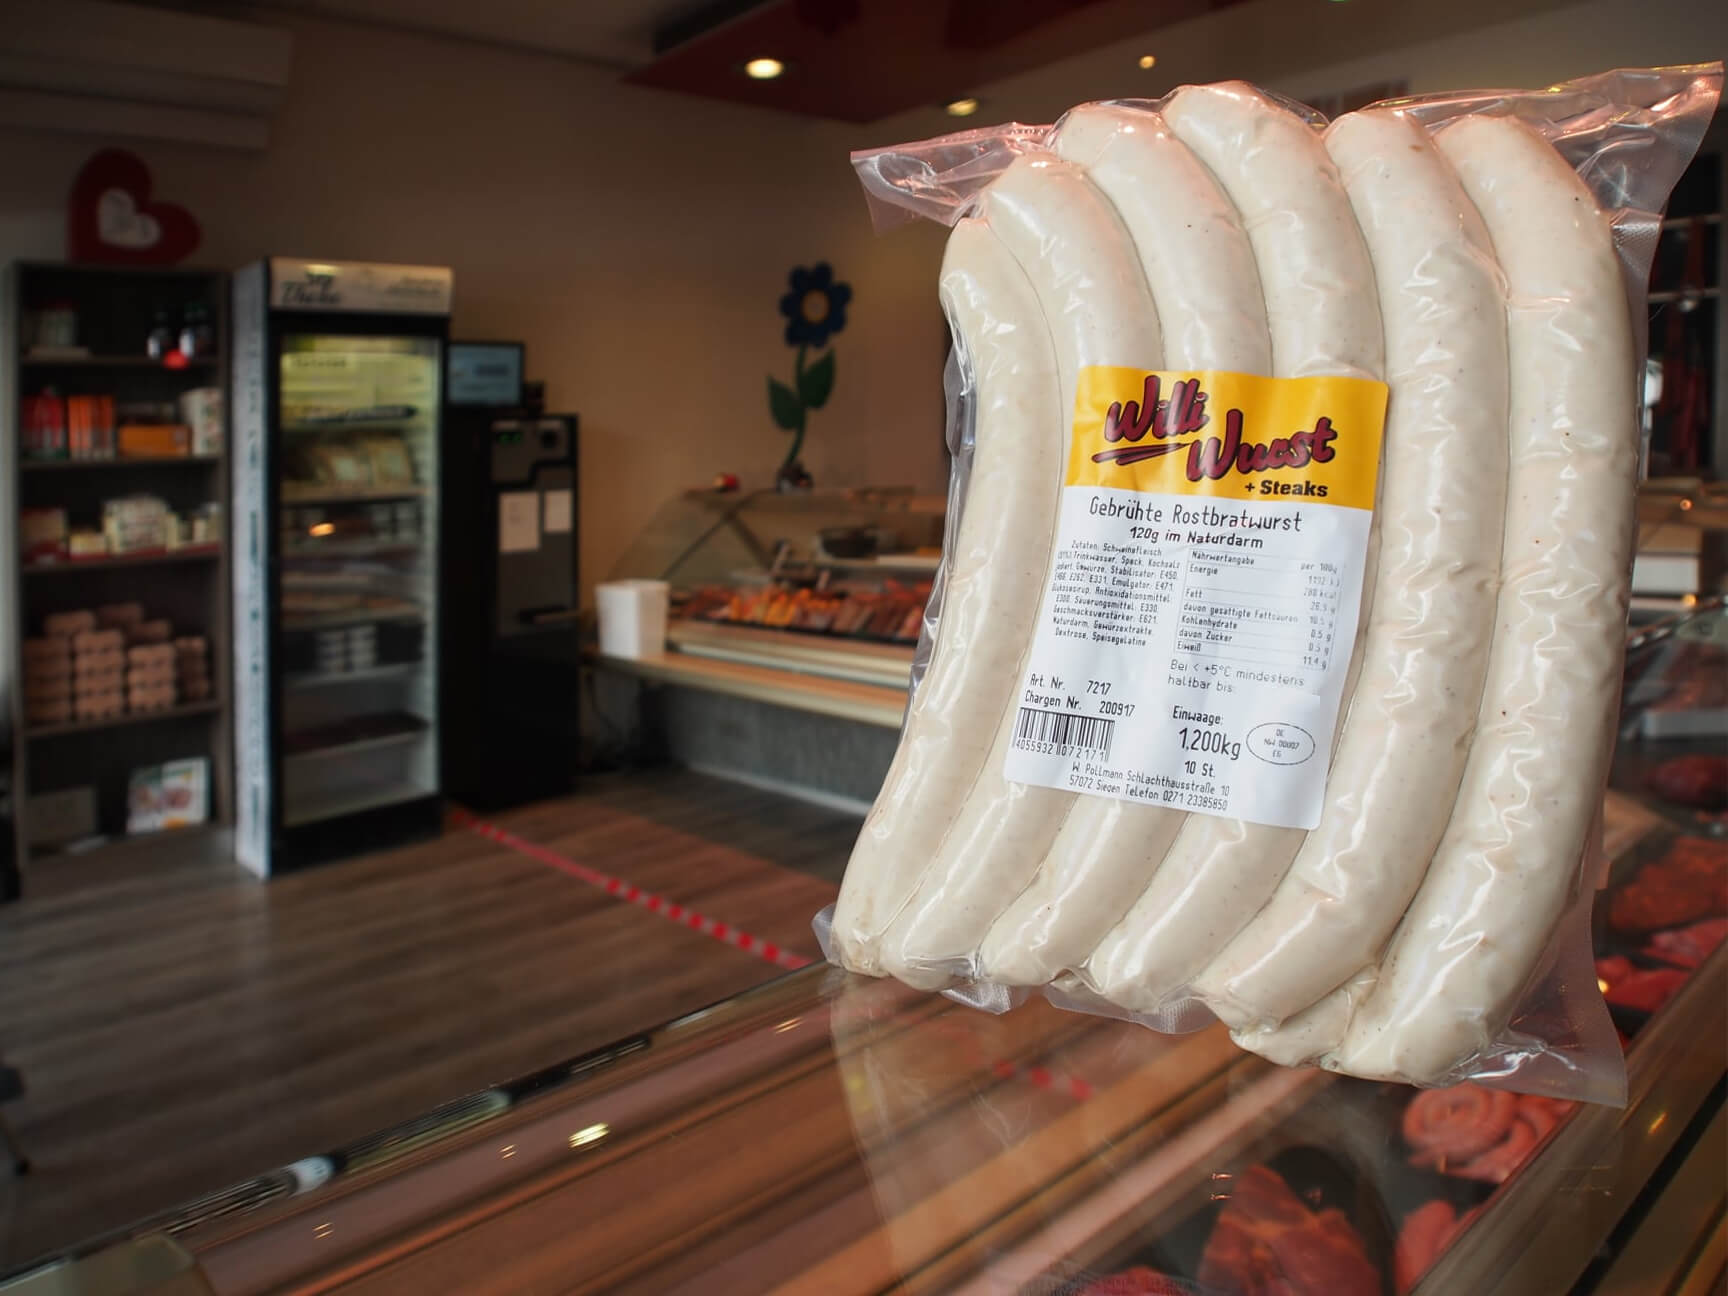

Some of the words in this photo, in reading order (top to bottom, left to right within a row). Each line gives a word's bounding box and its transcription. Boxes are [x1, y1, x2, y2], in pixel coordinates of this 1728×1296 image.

[1104, 375, 1209, 442] Willi
[1186, 409, 1338, 481] Wurst
[1245, 483, 1255, 493] +
[1260, 480, 1328, 497] Steaks
[1089, 496, 1162, 523] Gebrühte
[1172, 504, 1302, 532] Rostbratwurst
[1130, 526, 1158, 544] 120g
[1165, 529, 1180, 543] im
[1187, 529, 1263, 549] Naturdarm
[1189, 564, 1218, 576] Energie
[1186, 589, 1202, 599] Fett
[1184, 602, 1206, 612] davon
[1181, 615, 1238, 630] Kohlenhydrate
[1179, 628, 1202, 639] davon
[1205, 630, 1233, 643] Zucker
[1177, 641, 1202, 652] Eiweiß
[1170, 658, 1188, 671] Bei
[1236, 668, 1305, 687] mindestens
[1030, 673, 1046, 688] Art.
[1050, 676, 1066, 690] Nr.
[1086, 680, 1112, 695] 7217
[1025, 689, 1061, 707] Chargen
[1066, 695, 1083, 710] Nr.
[1099, 700, 1135, 717] 200917
[1173, 705, 1224, 726] Einwaage:
[1085, 763, 1123, 780] Pollmann
[1127, 769, 1215, 794] Schlachthausstraße
[1185, 761, 1196, 774] 10
[1202, 762, 1216, 778] St.
[1069, 774, 1094, 789] 57072
[1125, 784, 1159, 800] Telefon
[1163, 790, 1184, 803] 0271
[1187, 794, 1228, 811] 23385850
